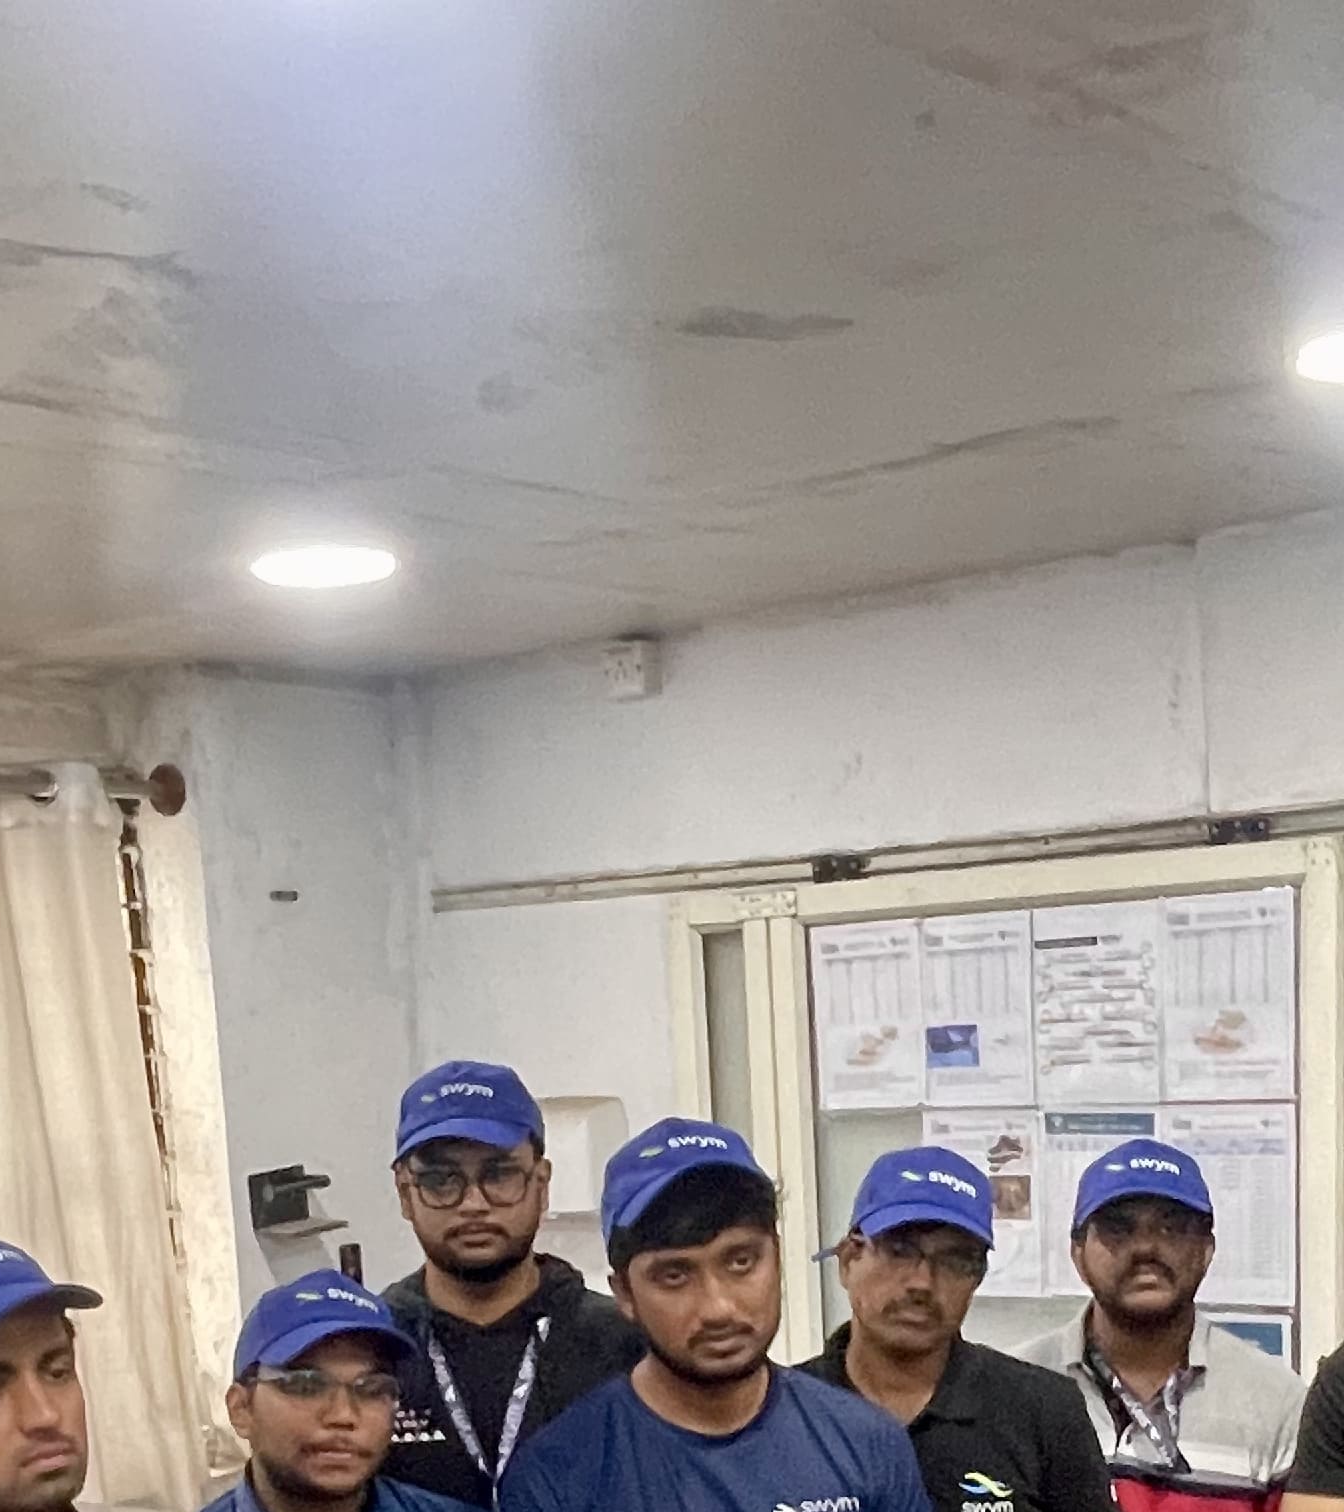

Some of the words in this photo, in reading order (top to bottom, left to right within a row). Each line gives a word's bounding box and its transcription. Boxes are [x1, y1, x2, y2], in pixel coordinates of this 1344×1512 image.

[440, 1083, 494, 1098] swym
[667, 1136, 728, 1150] swym
[1130, 1158, 1180, 1176] swym
[928, 1170, 977, 1198] swym
